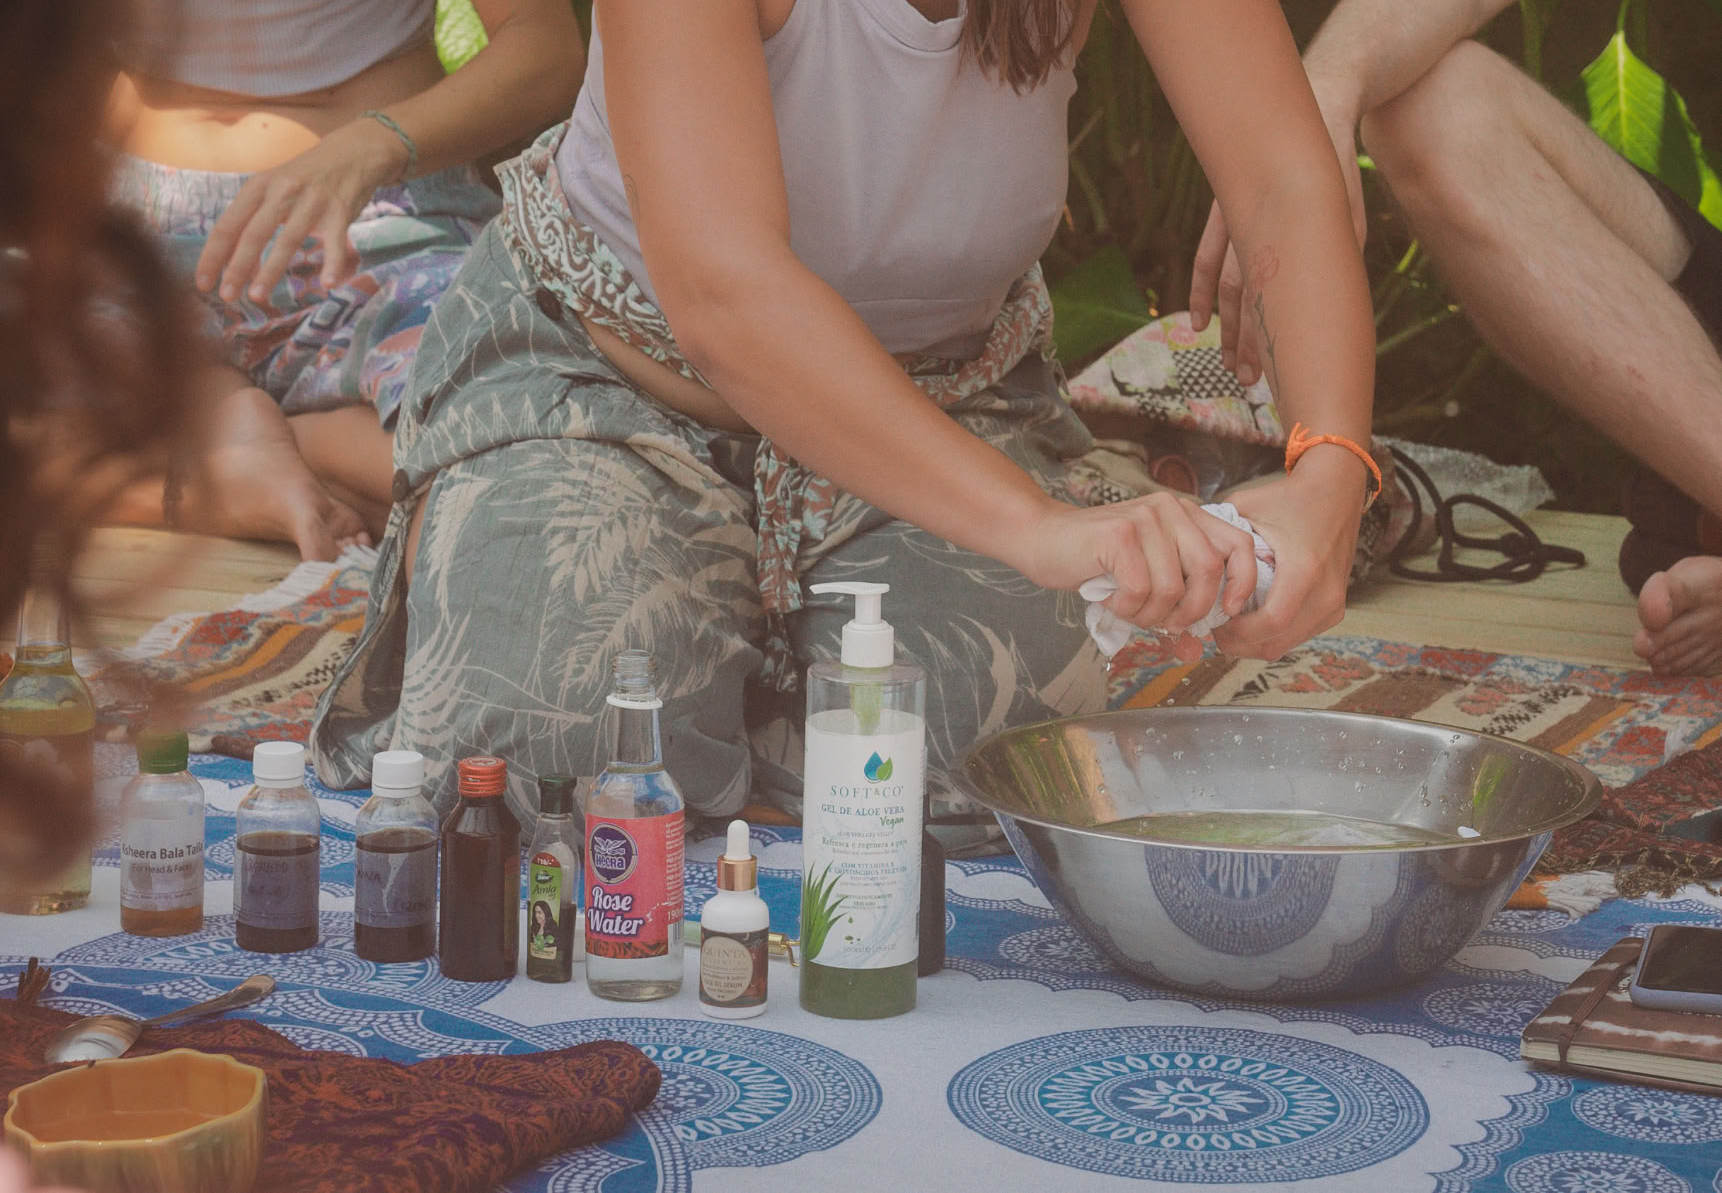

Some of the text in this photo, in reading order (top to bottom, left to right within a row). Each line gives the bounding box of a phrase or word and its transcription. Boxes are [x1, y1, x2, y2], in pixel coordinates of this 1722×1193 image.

[821, 804, 905, 816] GEL DE ALOE VERA
[880, 816, 905, 829] Vegan
[858, 840, 889, 849] regenera
[160, 847, 184, 860] Bala
[145, 865, 165, 874] Head
[166, 865, 173, 874] &
[532, 884, 557, 896] Amla
[592, 886, 633, 912] Rose
[588, 908, 644, 935] Water
